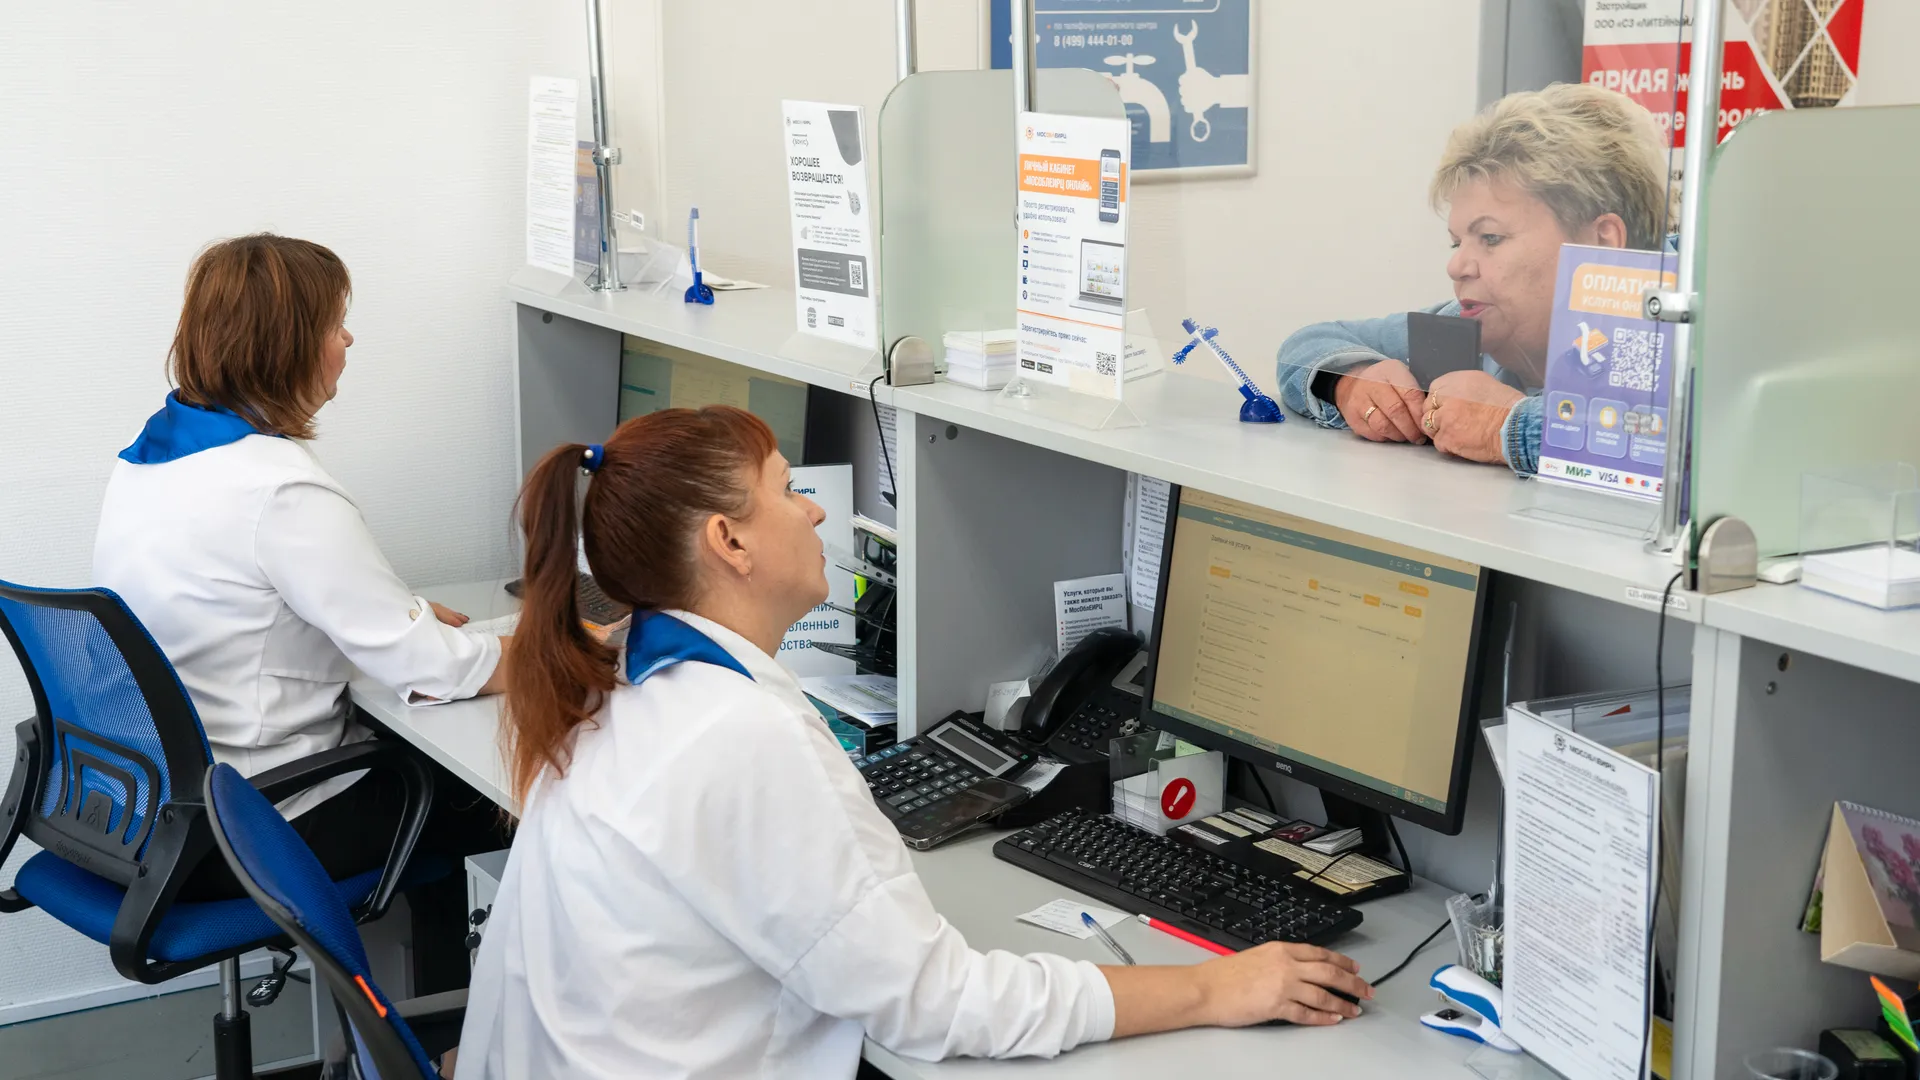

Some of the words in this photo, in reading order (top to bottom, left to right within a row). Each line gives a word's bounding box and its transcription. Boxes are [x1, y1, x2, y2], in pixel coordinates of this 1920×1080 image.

[1596, 2, 1647, 11] Застройщик
[1594, 18, 1615, 29] ООО
[1054, 35, 1060, 47] 8
[1062, 35, 1085, 48] (499)
[1087, 34, 1133, 46] 444-01-00
[1589, 69, 1669, 93] ЯРКАЯ
[1673, 71, 1745, 91] жнь
[790, 156, 820, 168] ХОРОШЕЕ
[1024, 160, 1048, 172] ЛИЧНЫЙ
[1049, 163, 1075, 175] КАБИНЕТ
[792, 171, 844, 184] ВОЗВРАЩАЕТСЯ!
[1582, 295, 1619, 309] УСЛУГИ
[1599, 471, 1619, 484] VISA
[1101, 593, 1123, 601] заказать
